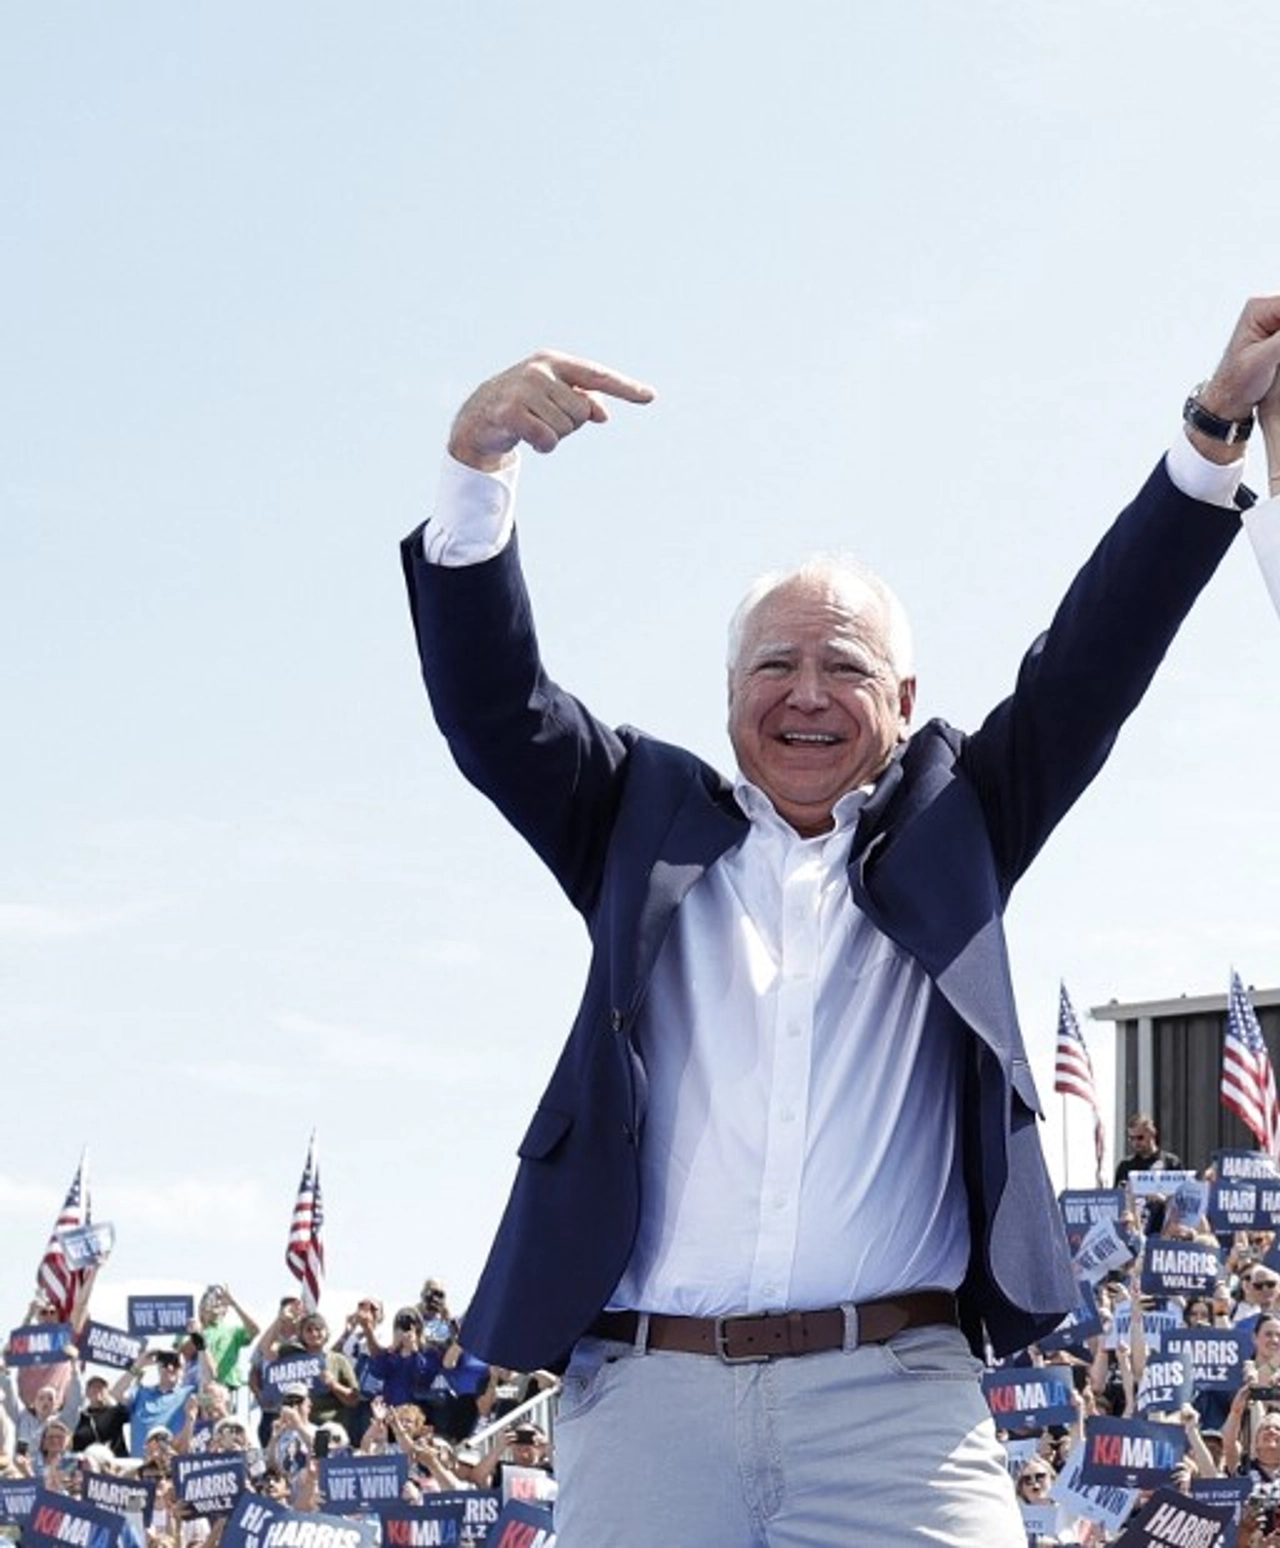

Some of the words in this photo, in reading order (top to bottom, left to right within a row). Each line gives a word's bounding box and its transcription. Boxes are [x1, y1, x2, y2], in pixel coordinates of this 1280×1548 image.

[1065, 1205, 1087, 1224] WE
[1152, 1250, 1218, 1277] HARRIS
[1162, 1274, 1206, 1289] WALZ
[133, 1310, 157, 1327] WE
[158, 1310, 187, 1327] WIN
[88, 1326, 141, 1359] HARRIS
[92, 1348, 129, 1367] WALZ
[269, 1358, 320, 1384] HARRIS
[1193, 1366, 1228, 1381] ALZ
[989, 1381, 1067, 1412] KAMALA
[1093, 1434, 1174, 1469] KAMALA
[185, 1471, 239, 1501] HARRIS
[328, 1476, 356, 1501] WE
[360, 1475, 399, 1499] WIN
[34, 1505, 112, 1548] KAMALA
[263, 1520, 362, 1548] HARRIS
[386, 1519, 457, 1546] KAMALA
